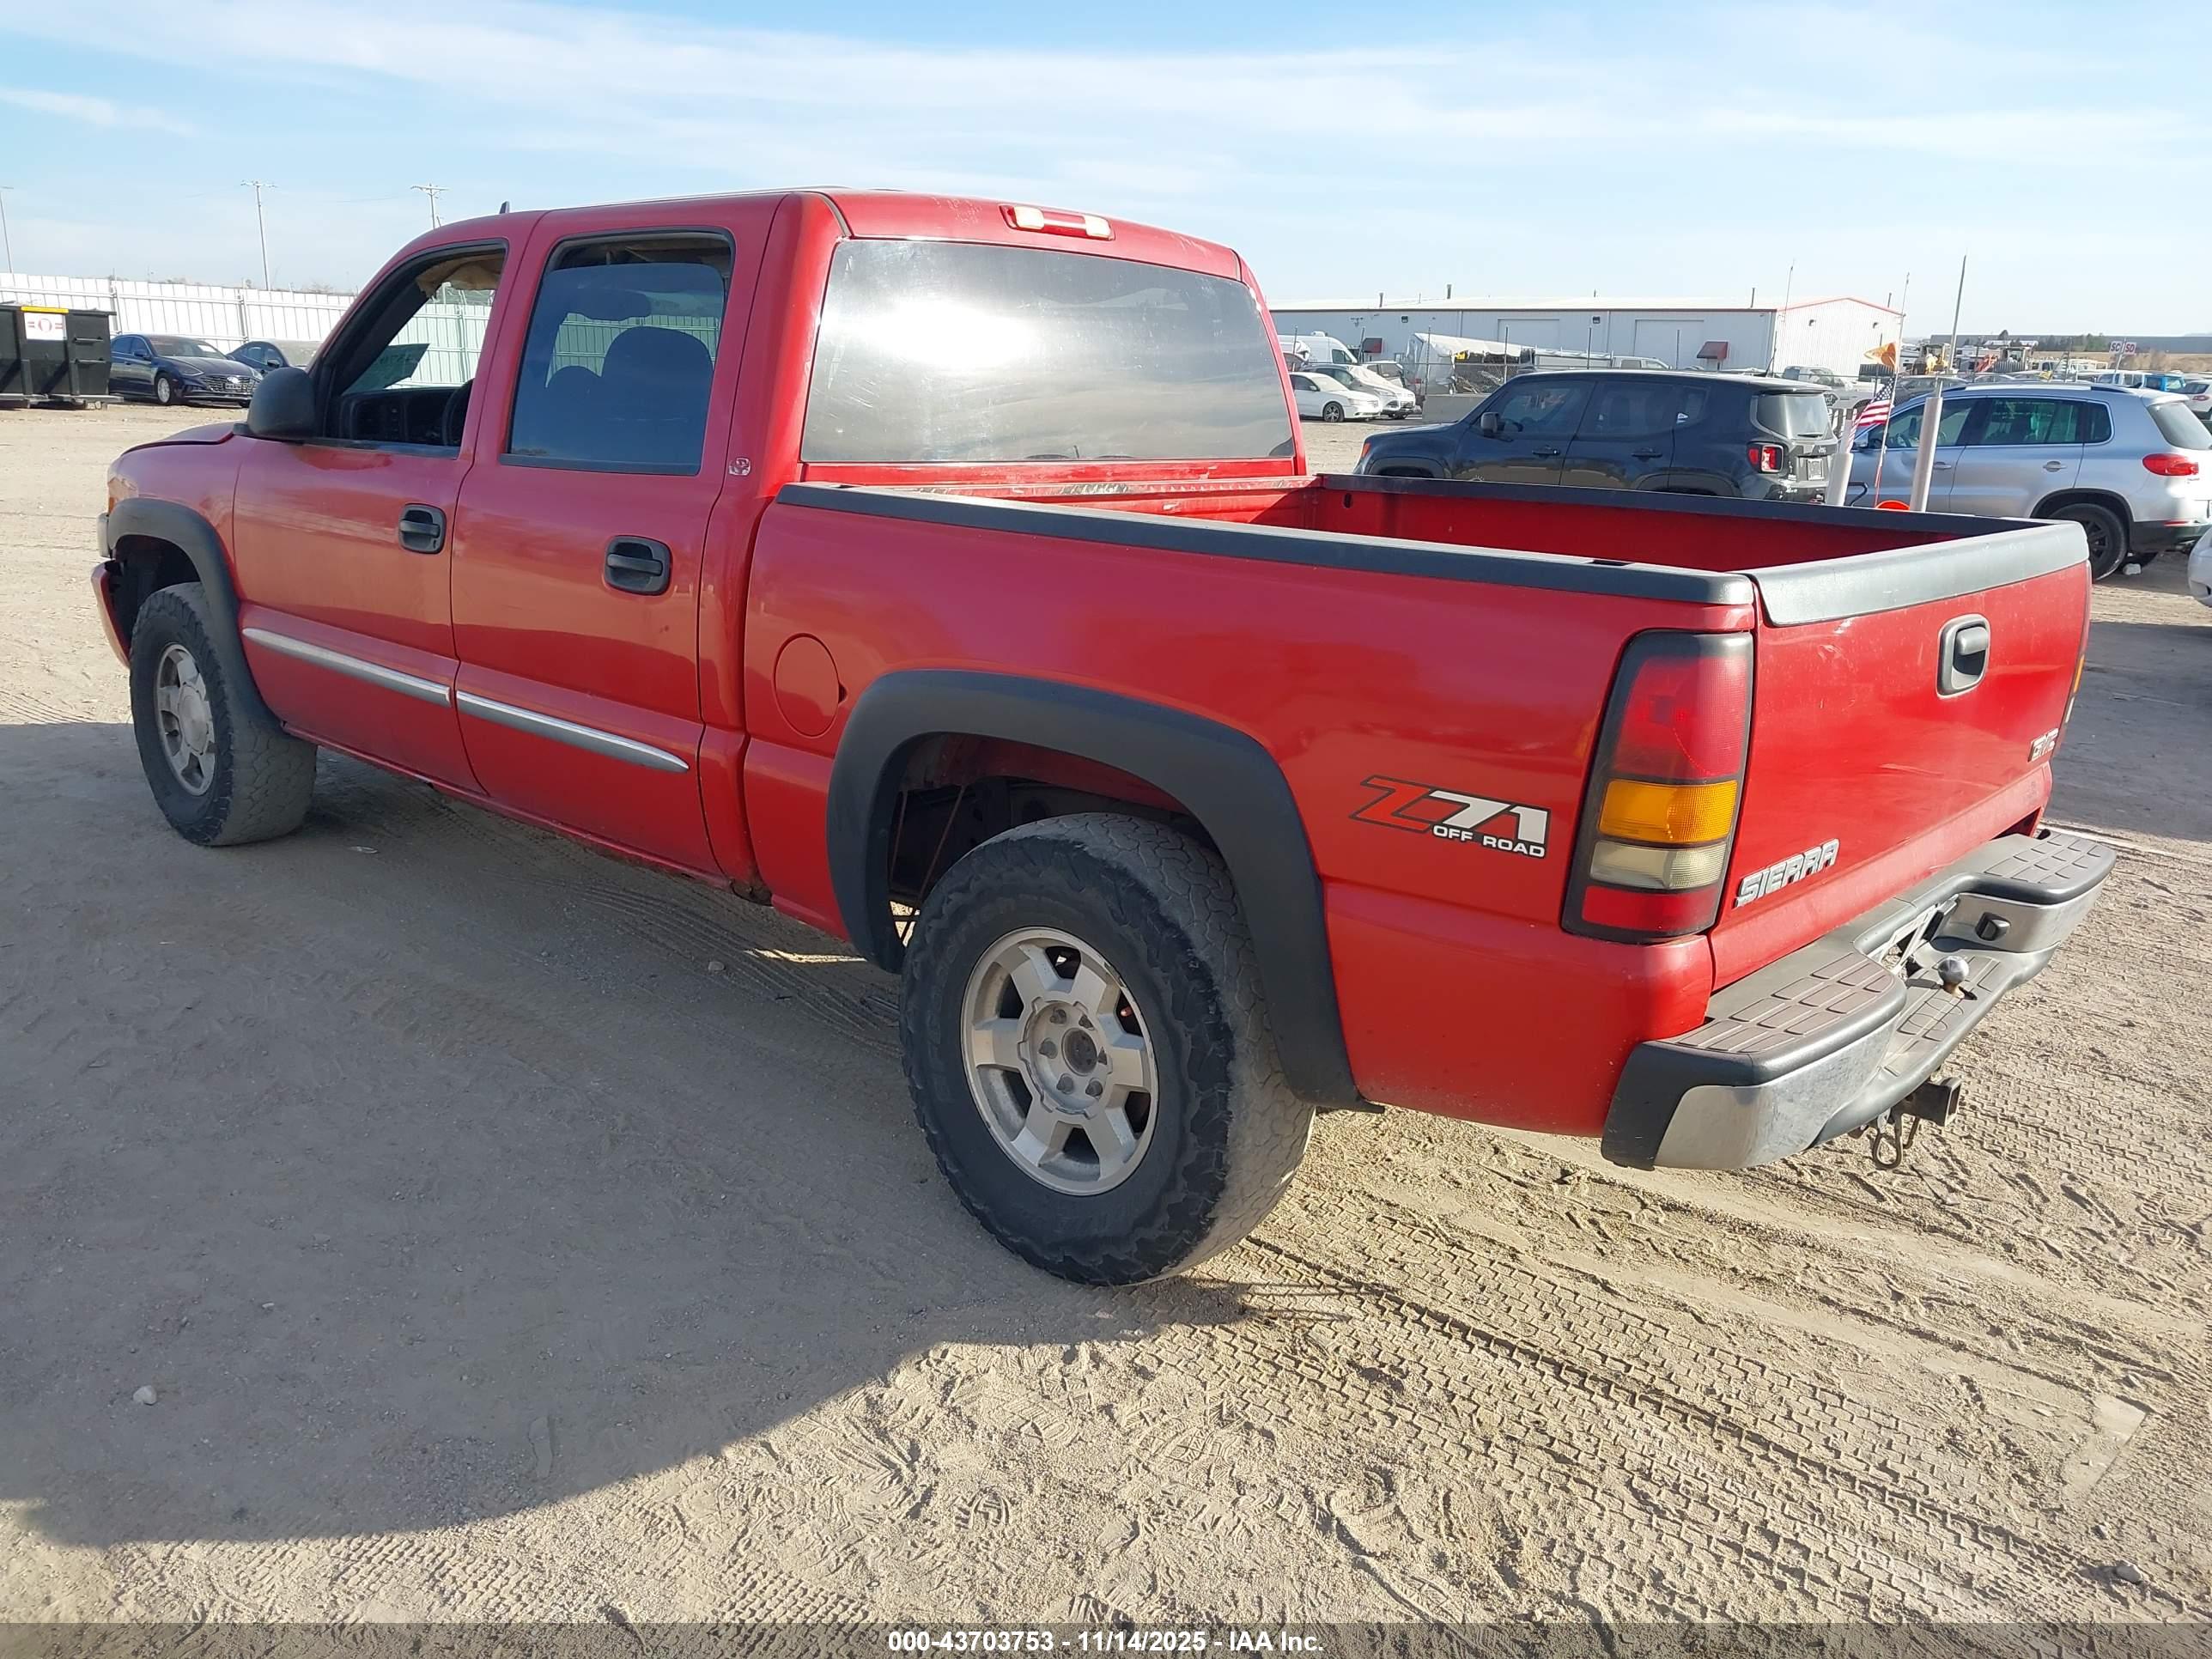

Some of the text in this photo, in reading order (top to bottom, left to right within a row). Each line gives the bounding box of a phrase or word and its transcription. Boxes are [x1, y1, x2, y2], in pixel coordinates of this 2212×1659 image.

[2111, 343, 2121, 352] SC
[2125, 343, 2136, 352] SD
[1349, 775, 1551, 845] Z71
[1432, 824, 1546, 859] OFF ROAD
[1735, 838, 1839, 908] SIERRA
